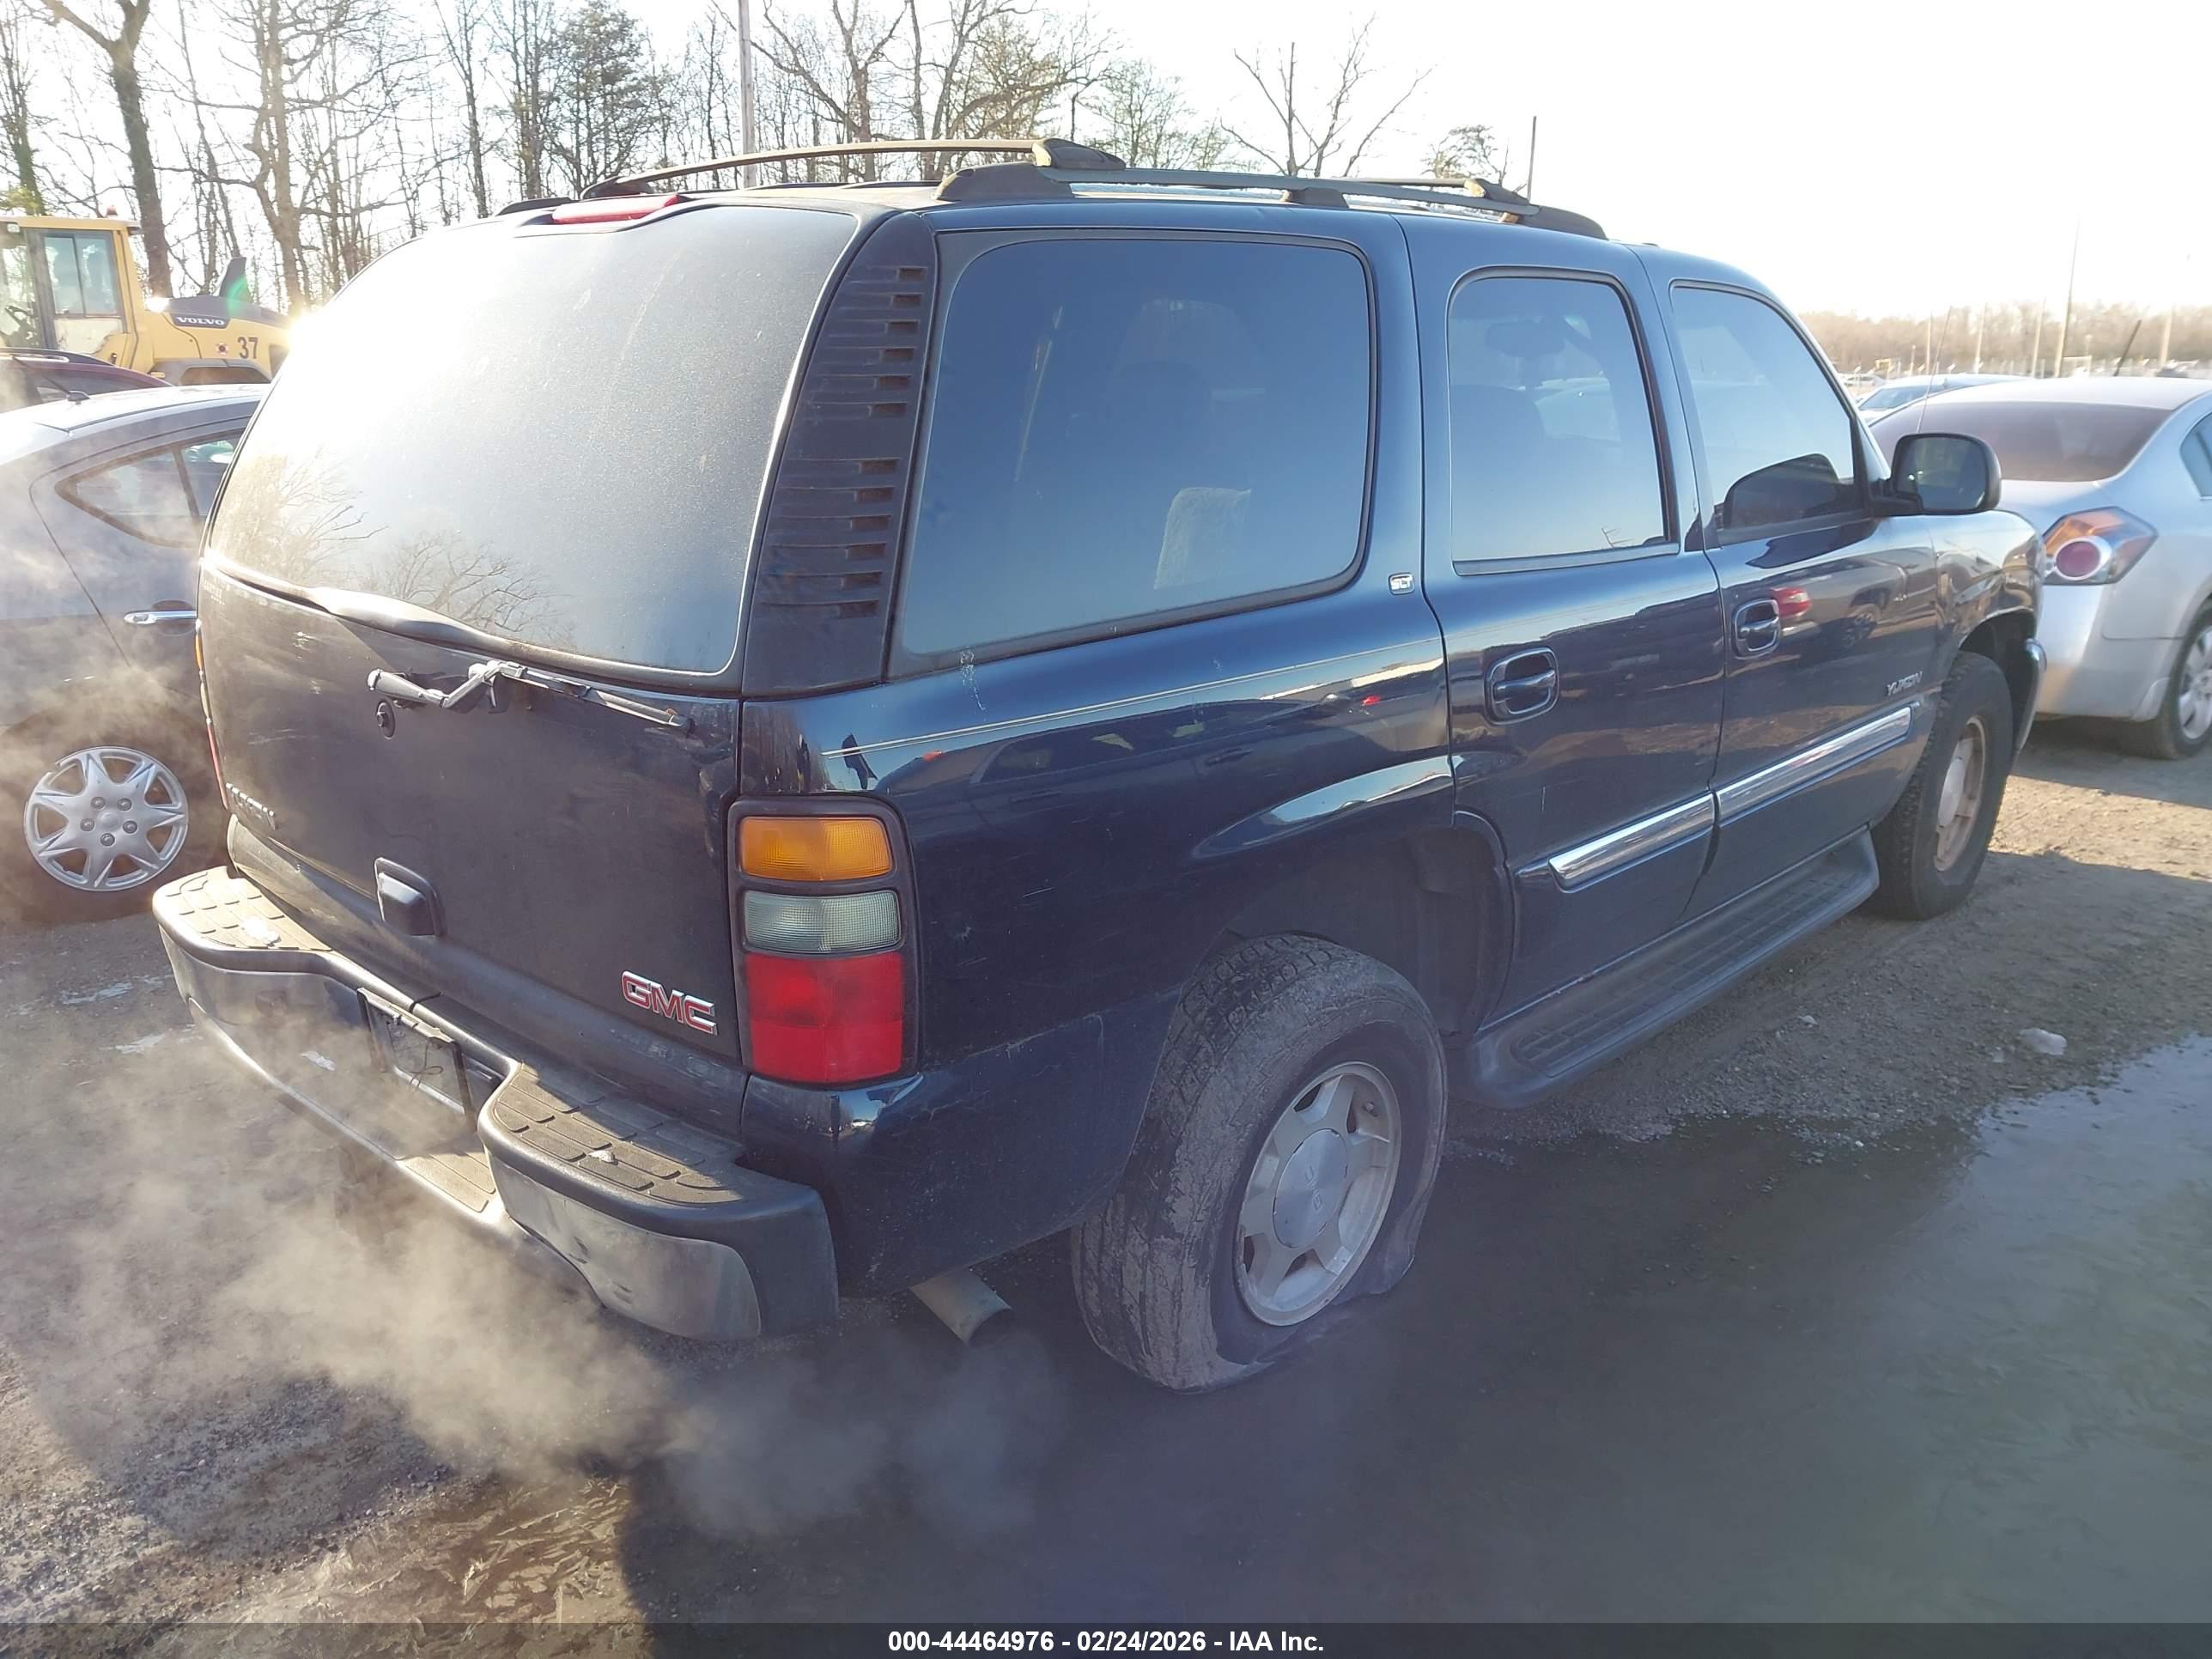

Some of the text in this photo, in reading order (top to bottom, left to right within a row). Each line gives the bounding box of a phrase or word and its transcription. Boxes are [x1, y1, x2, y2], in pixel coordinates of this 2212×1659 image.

[176, 316, 225, 327] VOLVO
[237, 336, 259, 360] 37
[621, 970, 718, 1036] GMC
